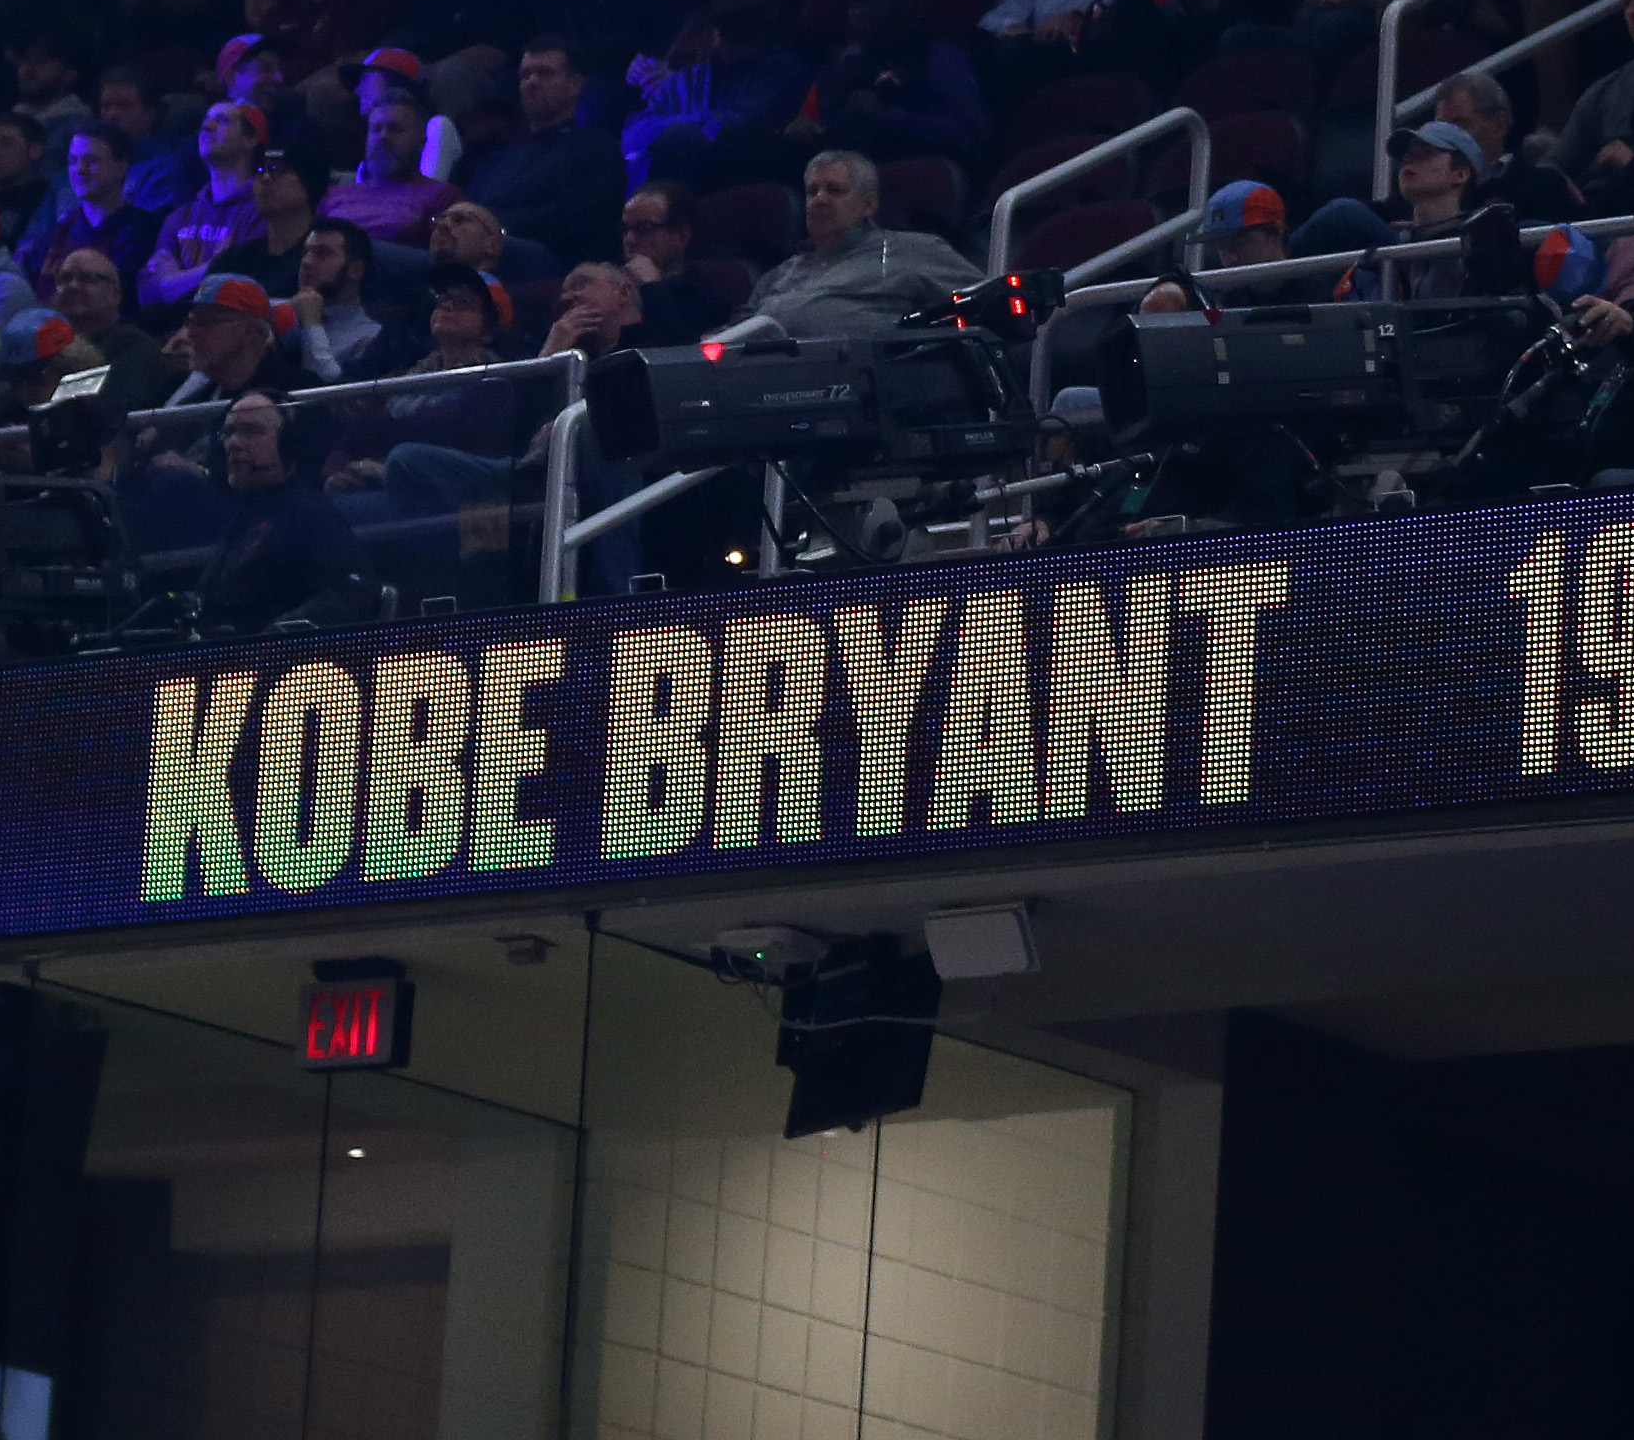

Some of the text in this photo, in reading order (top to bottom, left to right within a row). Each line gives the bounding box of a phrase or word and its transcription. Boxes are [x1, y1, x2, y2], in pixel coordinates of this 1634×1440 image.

[1377, 323, 1397, 337] 12
[141, 639, 565, 903] KOBE
[600, 560, 1291, 862] BRYANT
[306, 987, 386, 1060] EXIT
